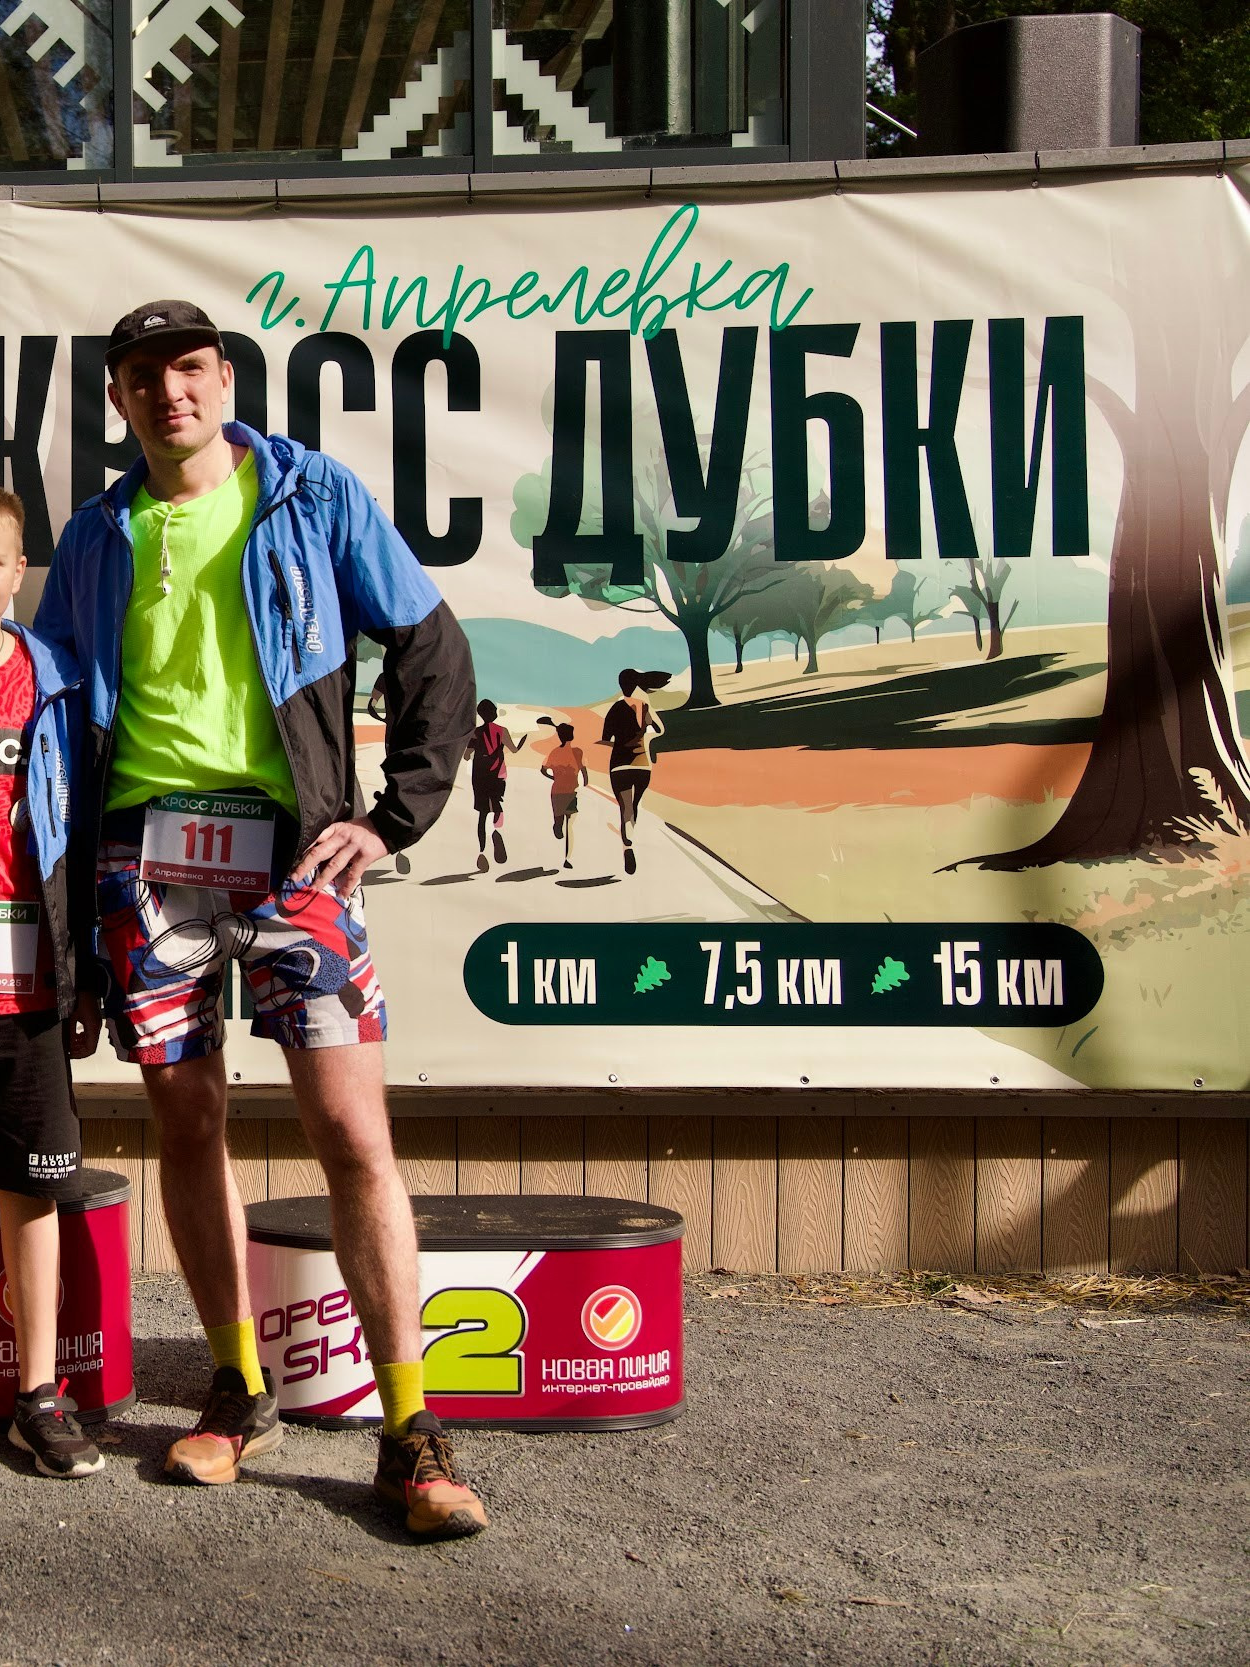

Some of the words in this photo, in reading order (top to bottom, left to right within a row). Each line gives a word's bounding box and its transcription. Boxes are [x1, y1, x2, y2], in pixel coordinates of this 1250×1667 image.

[245, 270, 312, 331] г.
[317, 203, 814, 350] Апрелевка
[532, 315, 1091, 588] ДУБКИ
[161, 796, 209, 811] КРОСС
[211, 801, 262, 815] ДУБКИ
[181, 822, 233, 863] 111
[154, 867, 204, 881] Апрелевка
[212, 874, 257, 886] 14.09.25
[500, 941, 519, 1005] 1
[535, 959, 596, 1005] КМ
[700, 942, 762, 1010] 7,5
[779, 959, 842, 1005] КМ
[933, 942, 981, 1006] 15
[998, 959, 1064, 1006] КМ
[260, 1289, 357, 1342] OPE
[422, 1286, 525, 1395] 2
[55, 1330, 104, 1361] ИНИЯ
[283, 1325, 370, 1385] SK
[542, 1358, 614, 1380] НОВАЯ
[618, 1349, 670, 1379] ЛИНИЯ
[542, 1374, 670, 1395] интернет-провайдер
